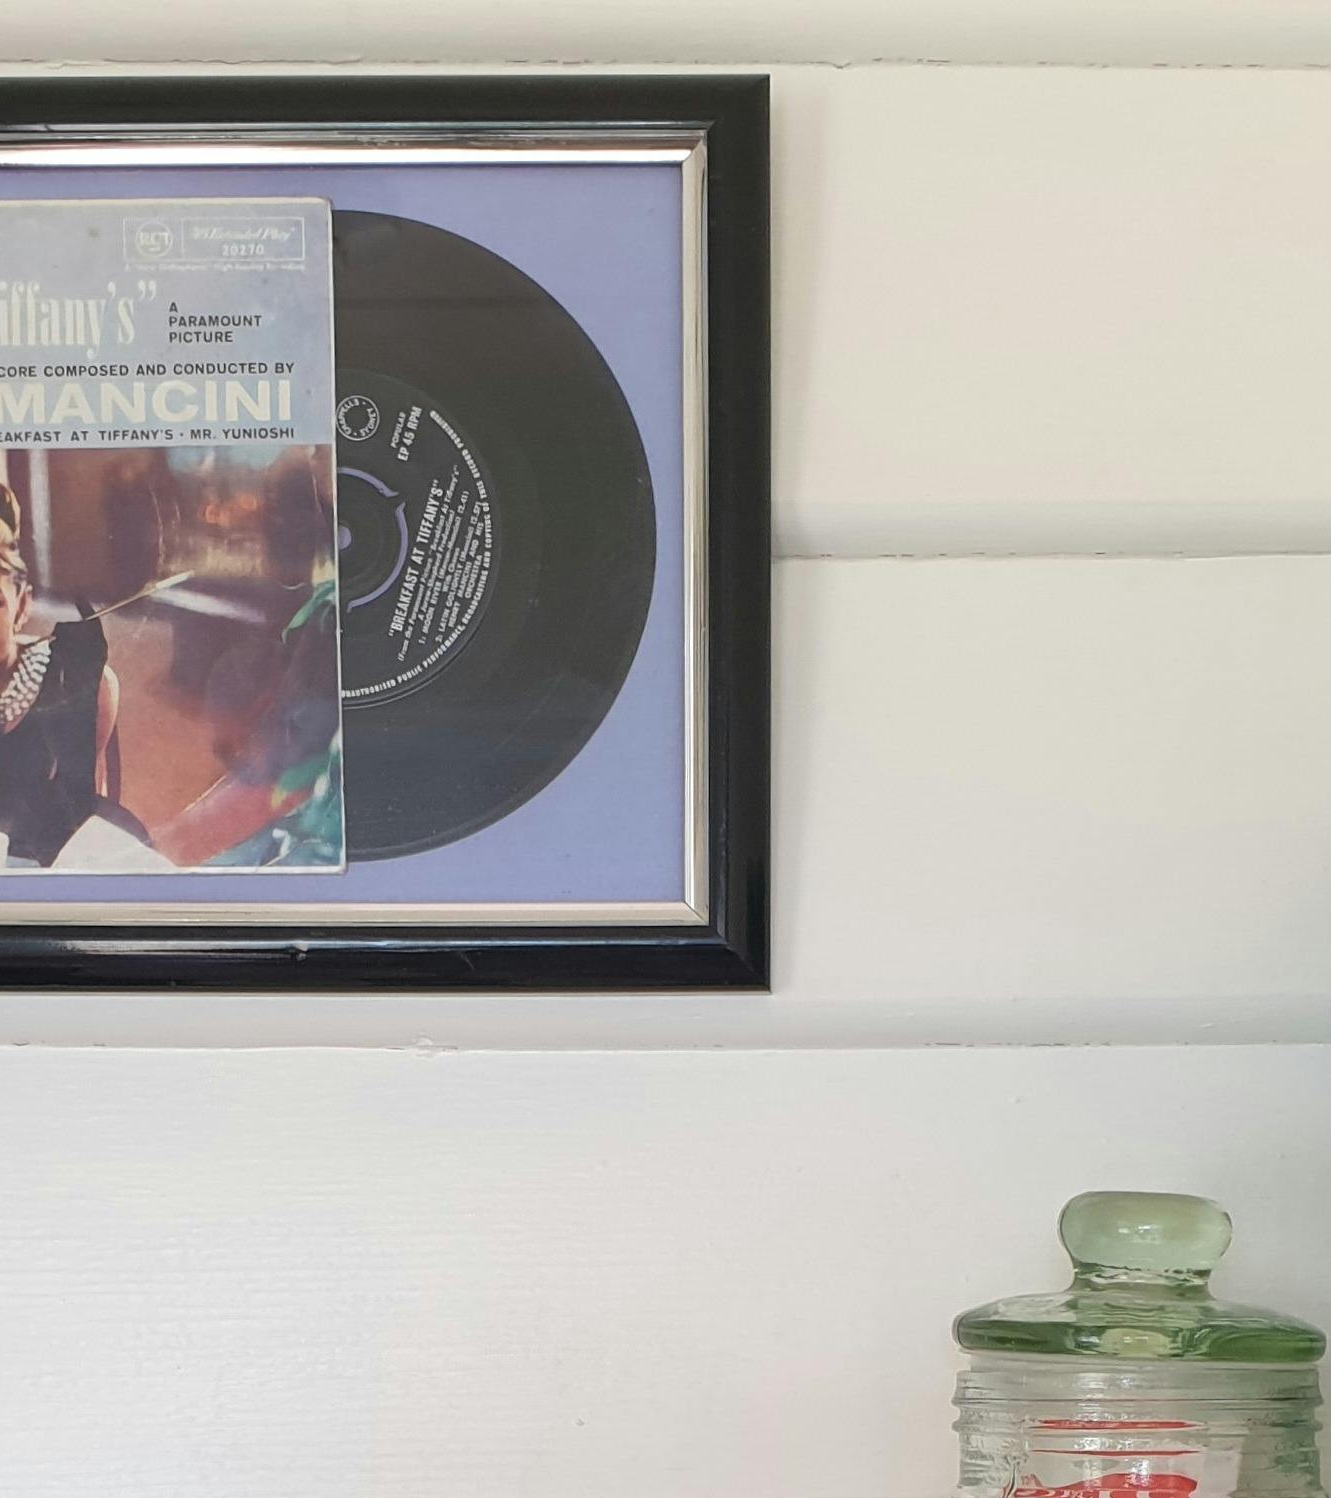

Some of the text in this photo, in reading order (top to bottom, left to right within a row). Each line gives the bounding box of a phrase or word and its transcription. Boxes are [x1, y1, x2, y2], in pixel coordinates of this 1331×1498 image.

[169, 302, 178, 313] A
[169, 314, 262, 328] PARAMOUNT
[169, 331, 234, 343] PICTURE
[44, 364, 130, 377] COMPOSED
[136, 363, 167, 376] AND
[173, 362, 269, 376] CONDUCTED
[275, 362, 295, 374] BY
[359, 407, 377, 437] SYDNEY
[71, 430, 89, 441] AT
[99, 429, 174, 441] TIFFANY'S
[190, 428, 217, 440] MR.
[223, 427, 295, 439] YUNIOSHI
[390, 411, 406, 449] POPULAR
[397, 405, 423, 461] EP 45 RPM
[410, 546, 426, 564] AT
